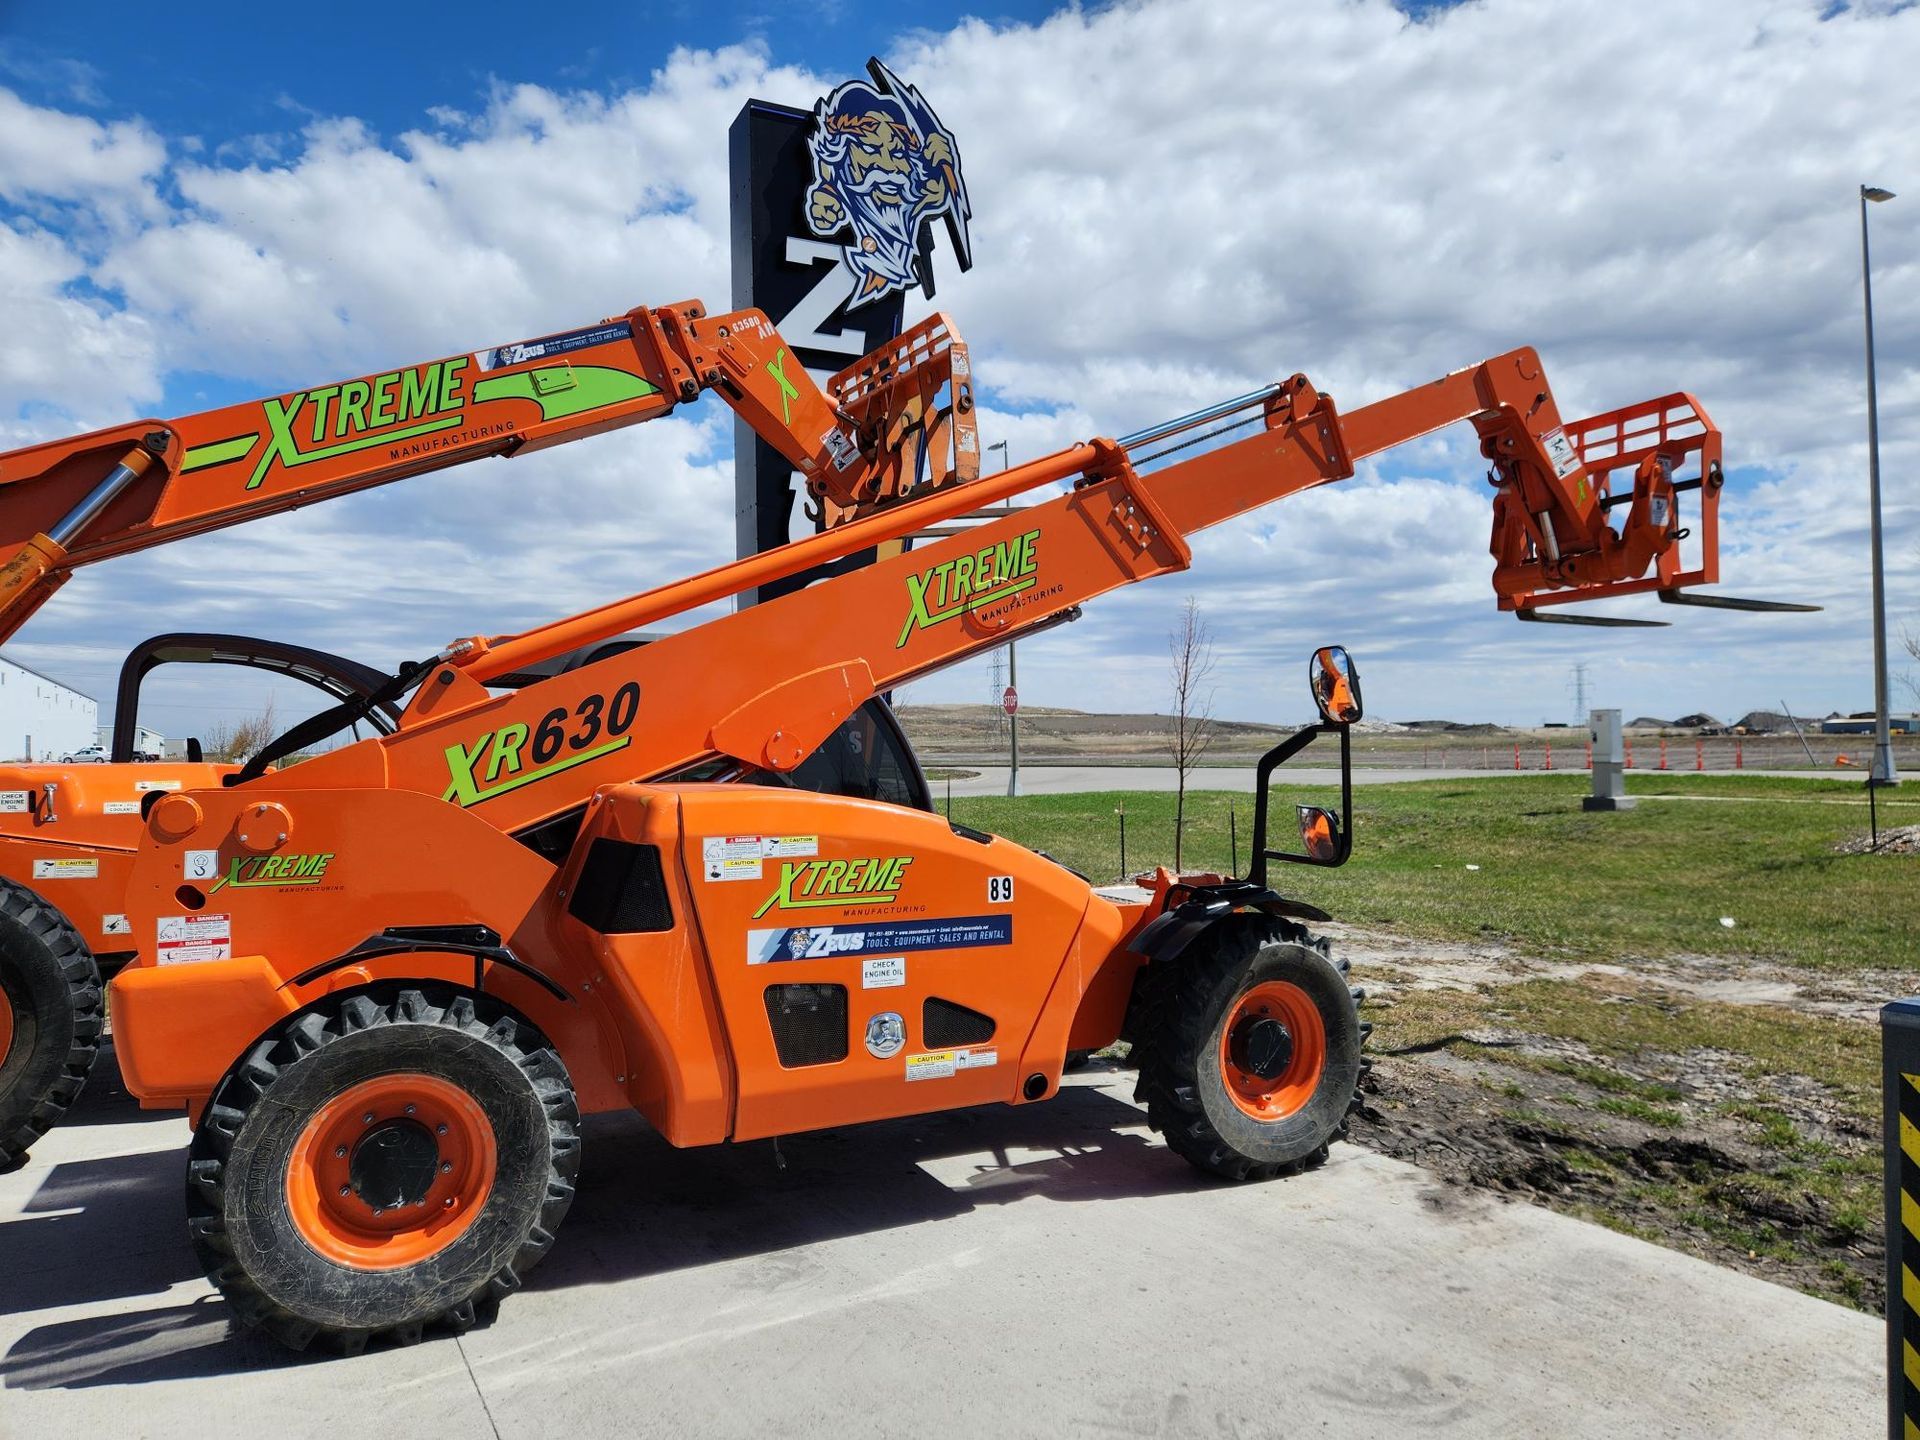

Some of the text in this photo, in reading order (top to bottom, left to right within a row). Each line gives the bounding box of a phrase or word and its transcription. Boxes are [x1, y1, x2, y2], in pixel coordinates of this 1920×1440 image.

[511, 344, 545, 364] ZEUS
[245, 357, 469, 490] XTREME
[390, 420, 516, 460] MANUFACTURING
[895, 528, 1041, 649] XTREME
[981, 583, 1064, 622] MANUFACTURING
[208, 853, 335, 894] XTREME
[278, 885, 345, 893] MANUFACTURING
[752, 857, 914, 919] XTREME
[990, 877, 1012, 901] 89
[196, 914, 225, 922] DANGER
[843, 904, 927, 917] MANUFACTURING
[184, 939, 213, 947] DANGER
[805, 927, 865, 958] ZEUS
[939, 932, 961, 943] SALES
[963, 931, 978, 941] AND
[979, 930, 1005, 940] RENTAL
[864, 968, 903, 978] ENGINE OIL
[872, 960, 896, 968] CHECK
[916, 1054, 945, 1063] CAUTION
